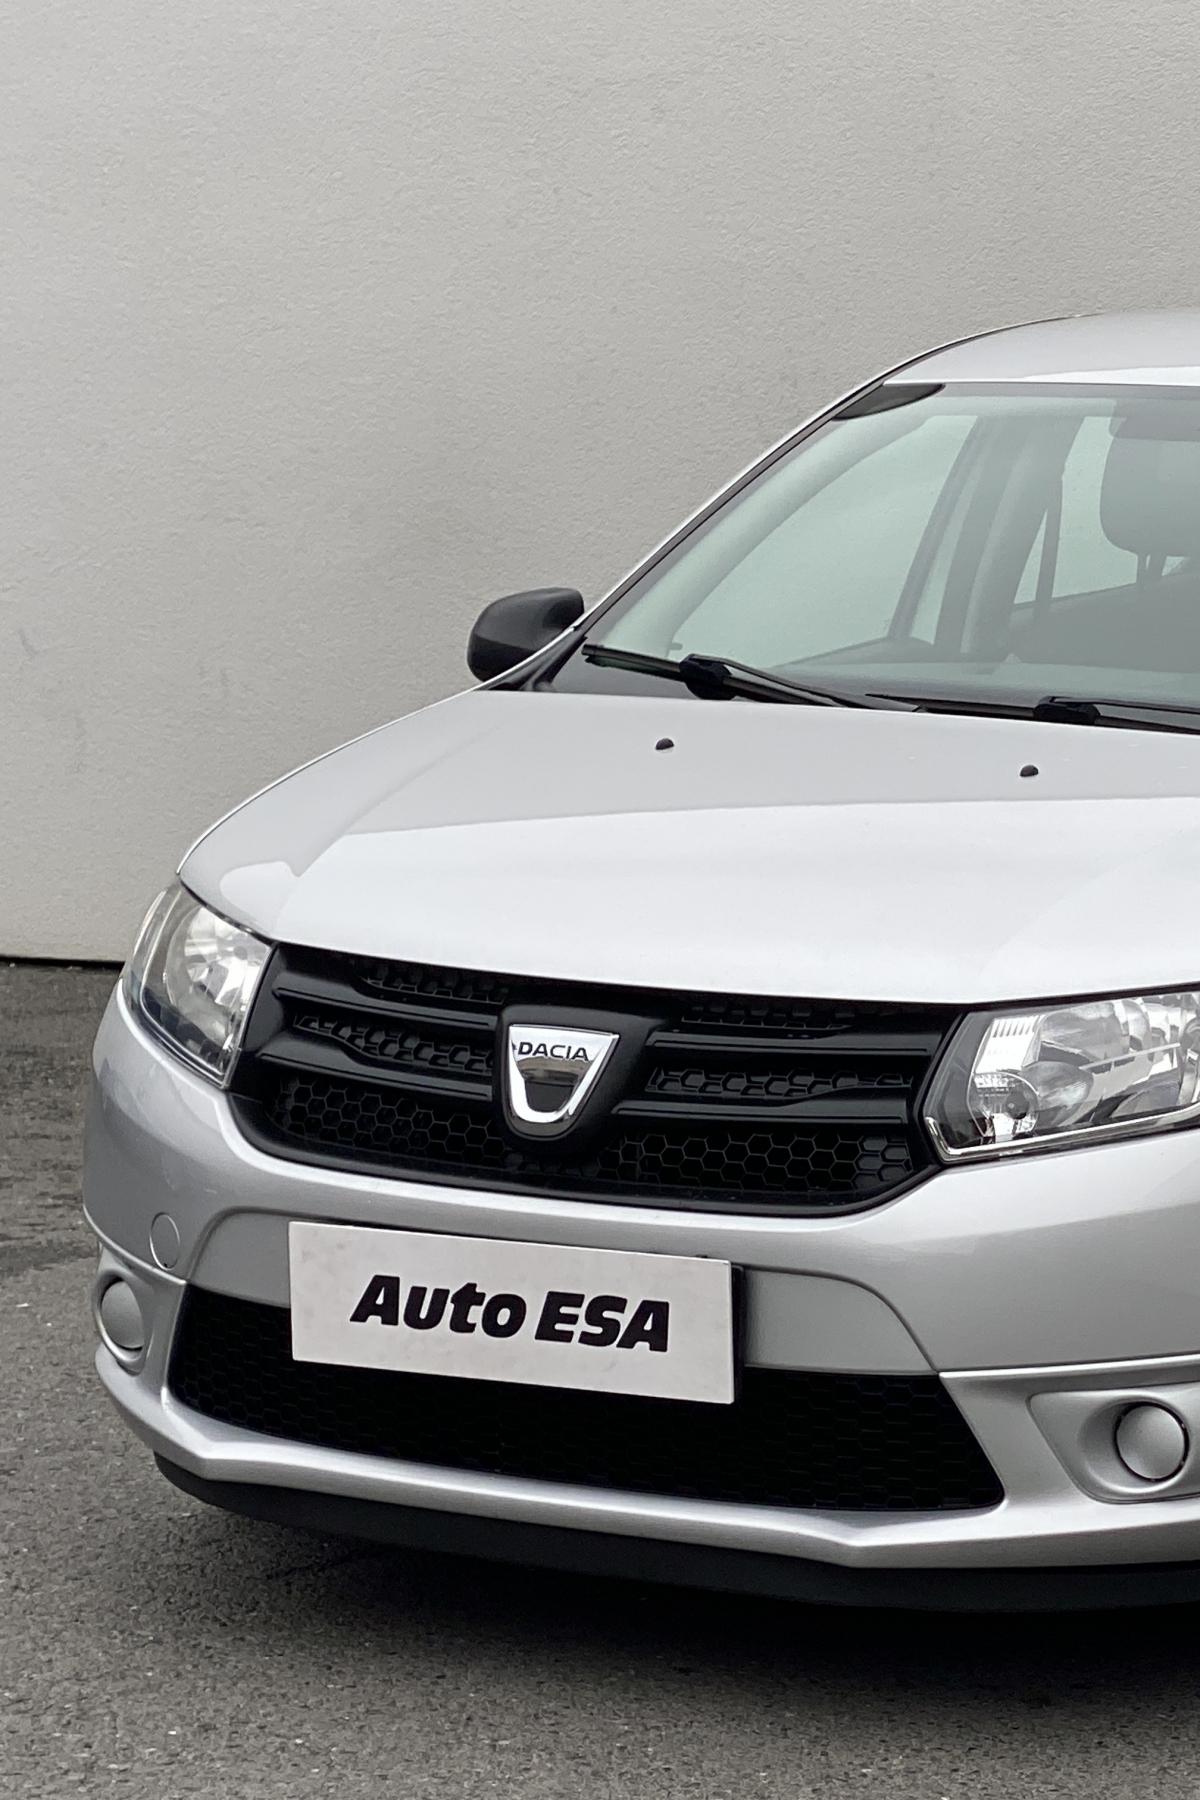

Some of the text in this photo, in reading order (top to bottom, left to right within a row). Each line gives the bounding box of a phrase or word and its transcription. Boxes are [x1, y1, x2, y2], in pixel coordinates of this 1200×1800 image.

[518, 1041, 589, 1062] DACIA
[350, 1275, 670, 1353] Auto ESA
